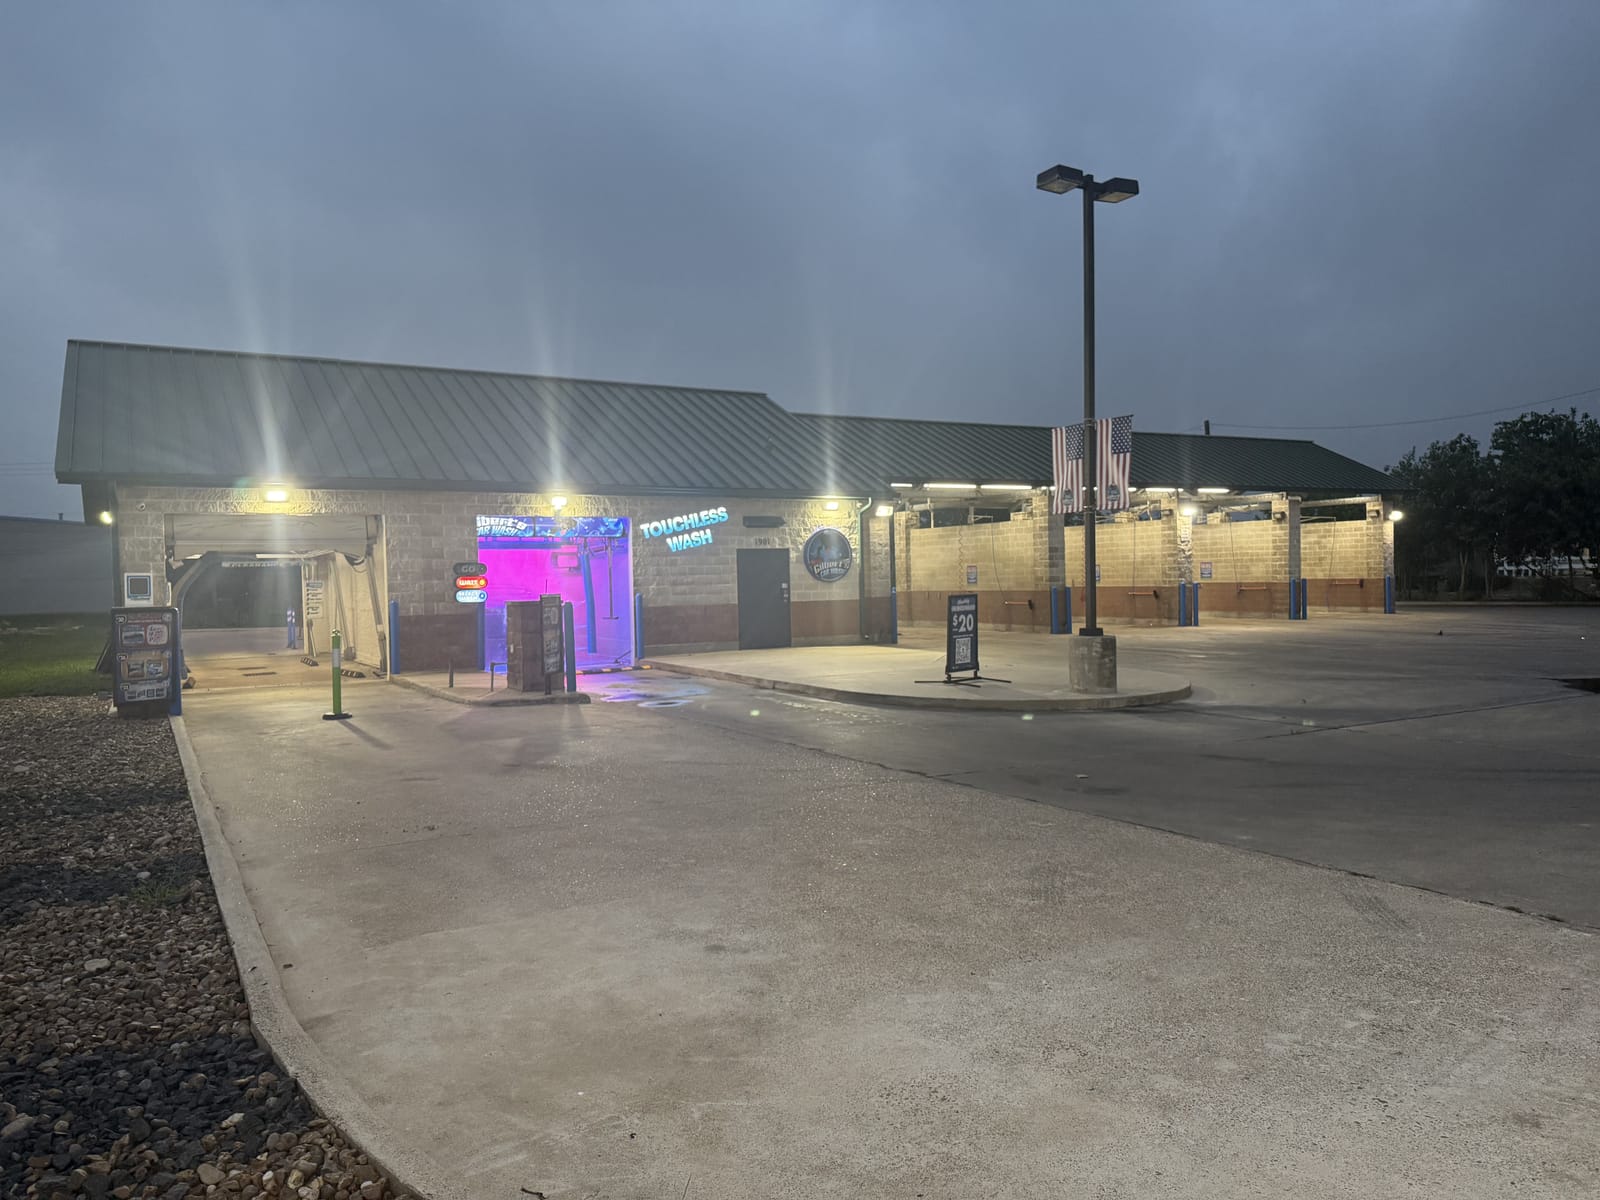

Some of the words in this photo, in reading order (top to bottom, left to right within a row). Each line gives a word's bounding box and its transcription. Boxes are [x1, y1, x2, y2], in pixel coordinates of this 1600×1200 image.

[640, 506, 729, 539] TOUCHLESS
[666, 529, 713, 552] WASH
[461, 564, 476, 573] GO
[952, 613, 974, 633] $20
